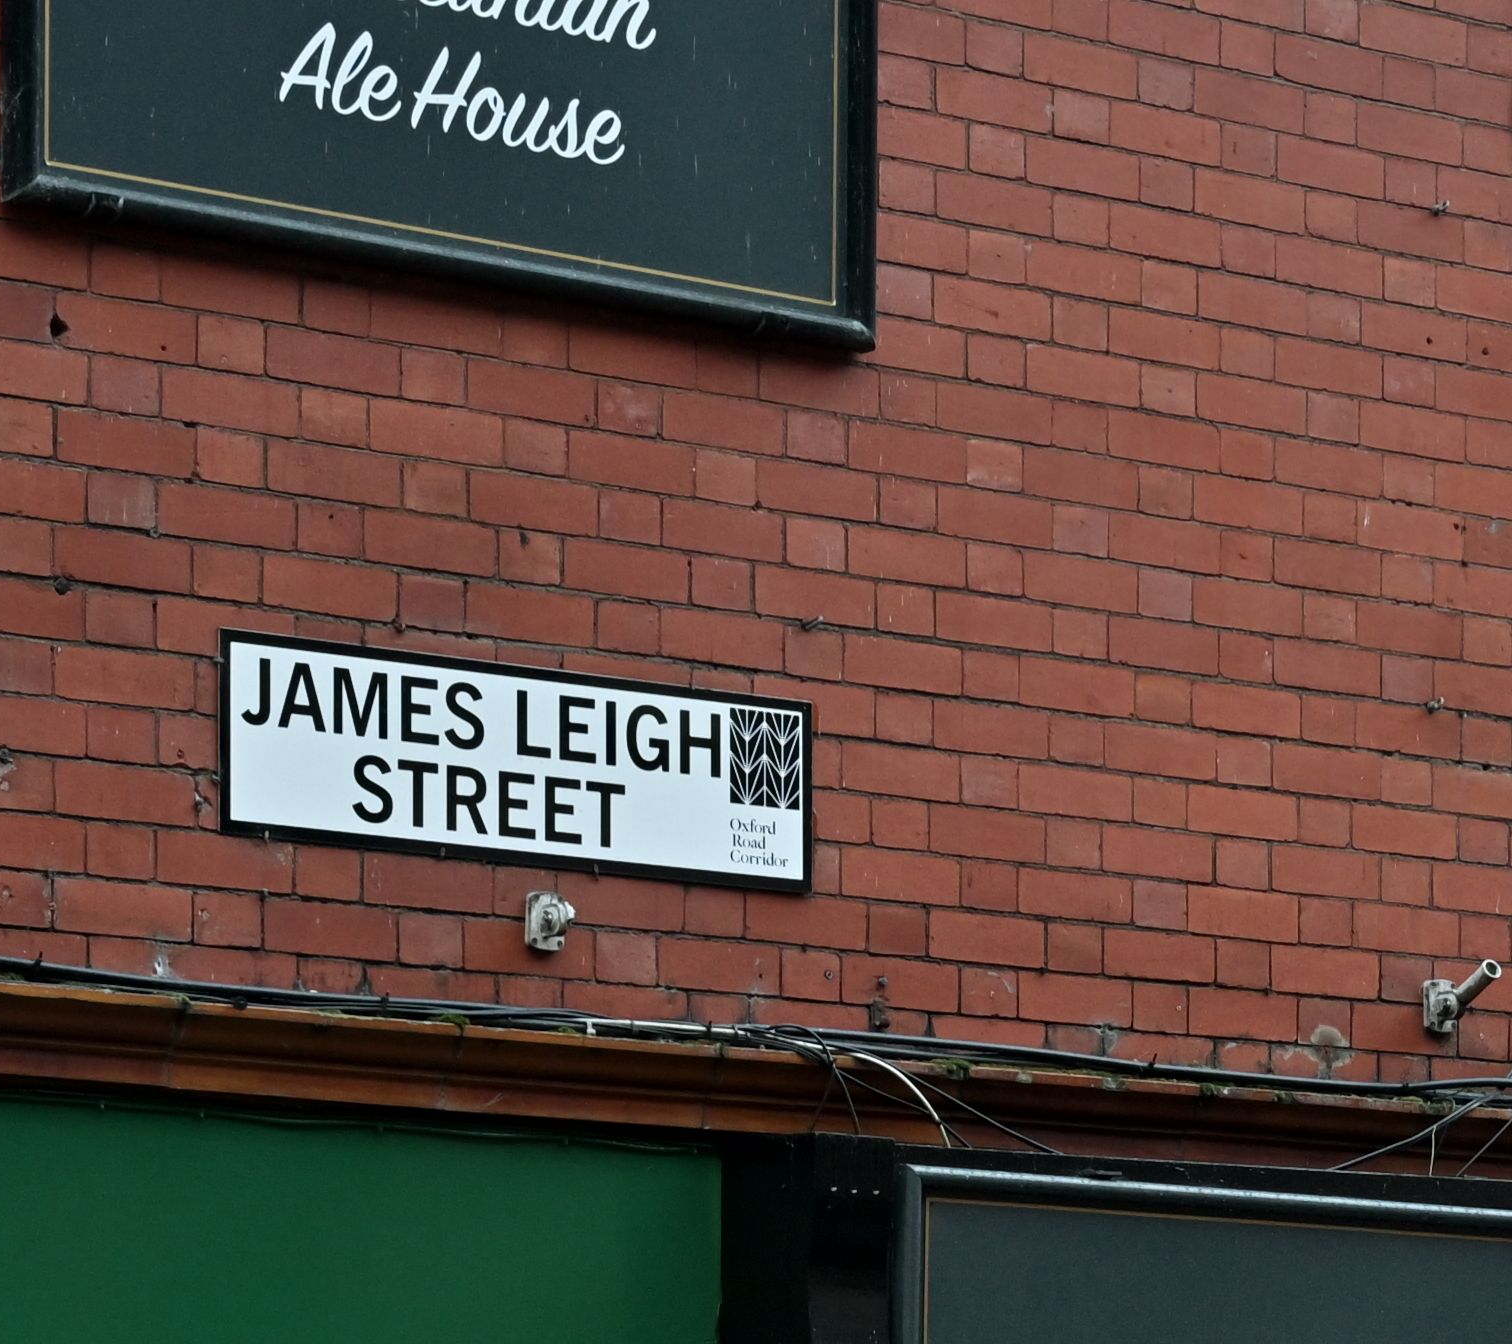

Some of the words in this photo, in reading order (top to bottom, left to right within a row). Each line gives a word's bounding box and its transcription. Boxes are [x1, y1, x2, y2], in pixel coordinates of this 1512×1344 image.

[279, 22, 401, 121] Ale
[411, 46, 626, 165] House
[241, 657, 486, 751] JAMES
[515, 689, 722, 779] LEIGH
[351, 754, 626, 849] STREET
[729, 818, 776, 835] Oxford
[730, 849, 789, 867] Corridor
[732, 833, 766, 850] Road
